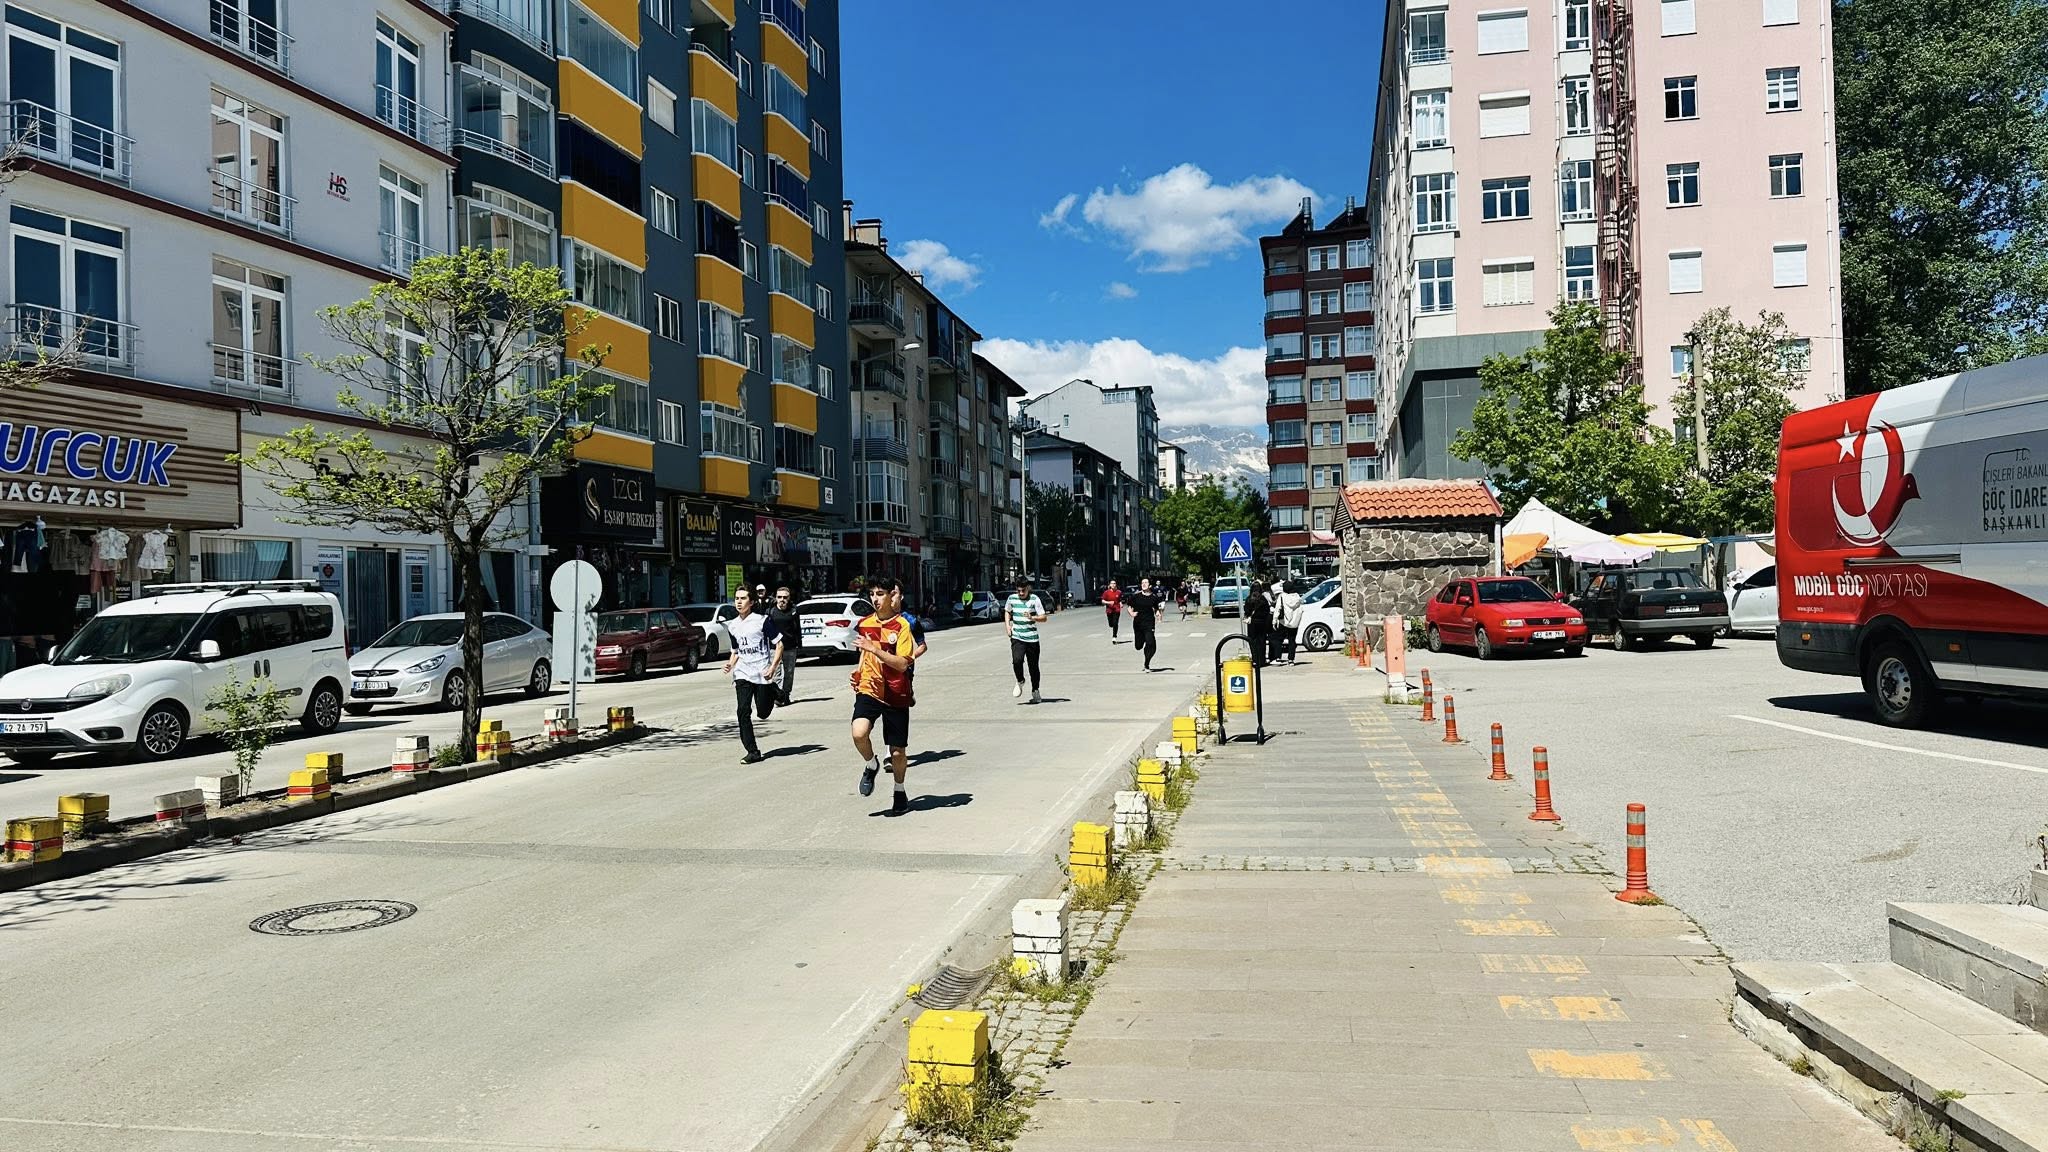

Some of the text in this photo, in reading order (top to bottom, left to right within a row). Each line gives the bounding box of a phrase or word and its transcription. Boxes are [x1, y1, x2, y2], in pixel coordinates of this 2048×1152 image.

[0, 481, 126, 509] AĞAZASI
[611, 472, 643, 502] İZGİ
[1983, 485, 2047, 515] GÖÇ İDARE
[603, 509, 624, 526] EŞARP
[626, 511, 655, 528] MERKEZİ
[686, 513, 718, 531] BALIM
[1793, 571, 1928, 597] MOBİL GÖÇ NOKTASI
[4, 723, 44, 732] 42 ZA 757
